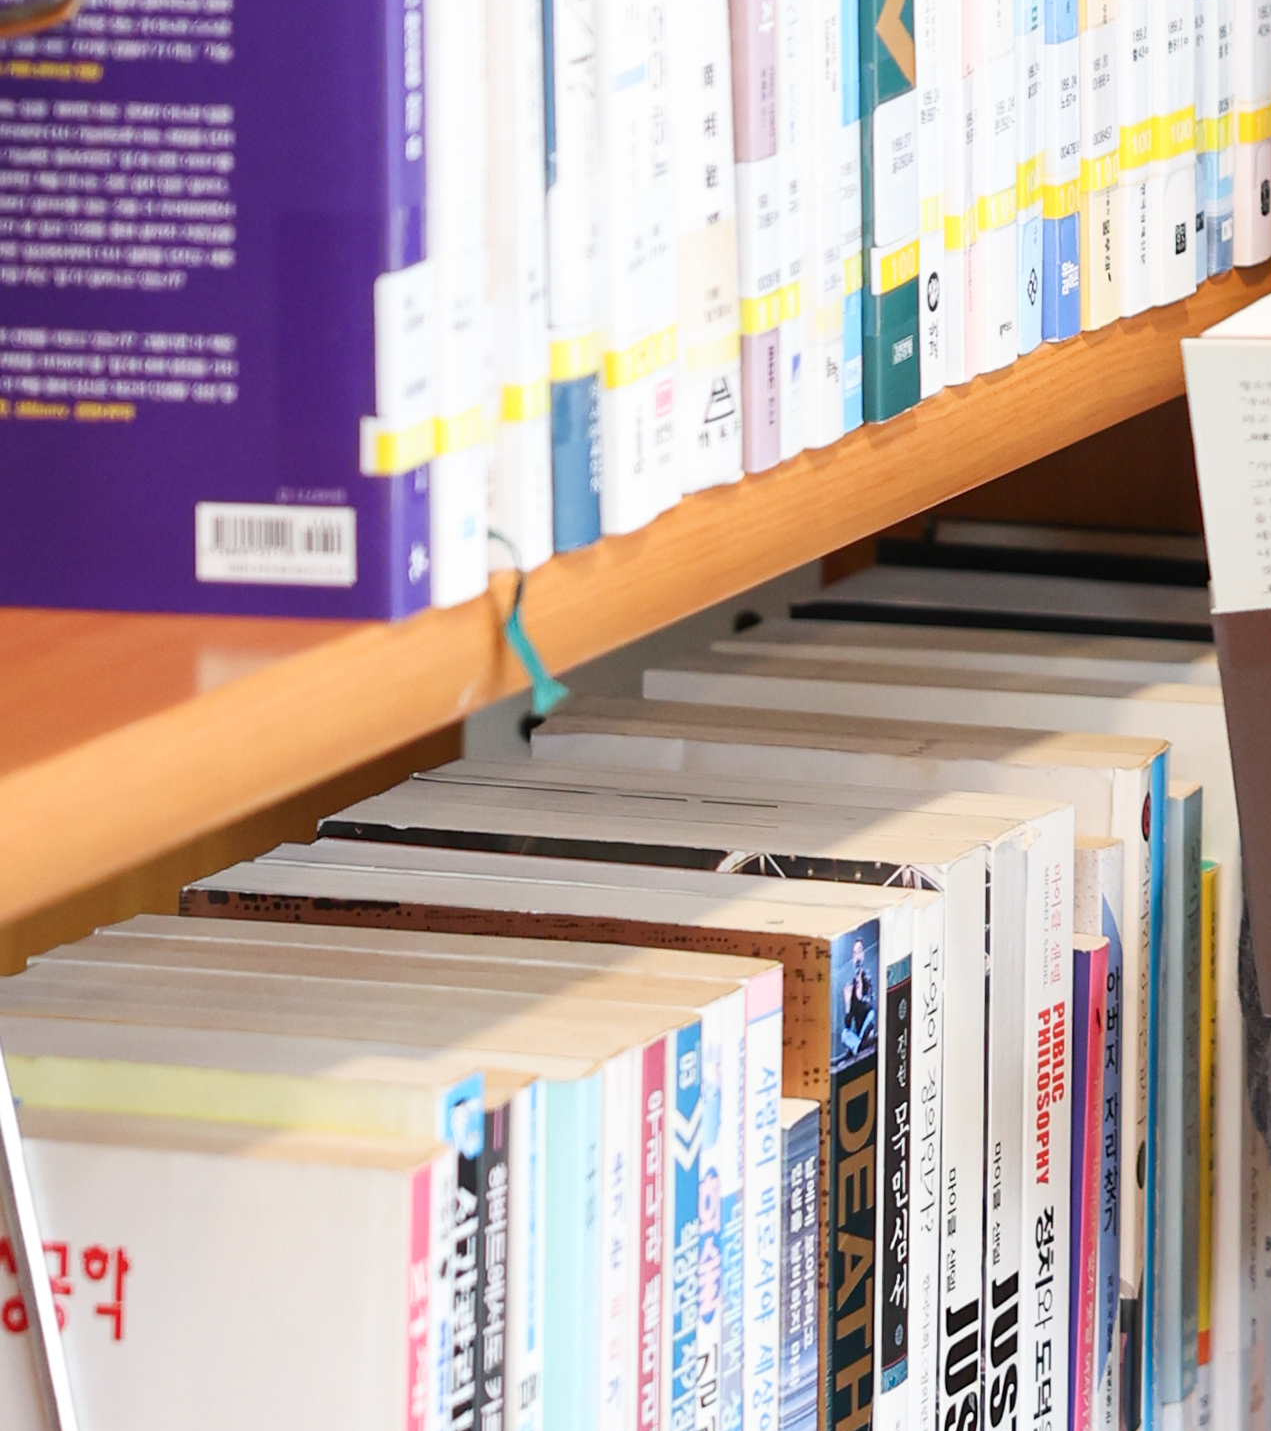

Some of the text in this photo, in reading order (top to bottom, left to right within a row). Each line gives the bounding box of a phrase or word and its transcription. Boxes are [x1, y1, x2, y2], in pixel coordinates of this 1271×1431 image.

[889, 243, 917, 277] 100
[920, 942, 939, 1234] 무엇이 정의인가?
[1035, 1007, 1052, 1187] PHILOSOPHY
[1051, 1002, 1067, 1103] PUBLIC
[756, 1066, 778, 1167] 사람이
[946, 1167, 957, 1239] 마이클
[992, 1139, 1002, 1211] 마이클
[753, 1186, 777, 1327] 바로서야
[1034, 1205, 1054, 1330] 정치와
